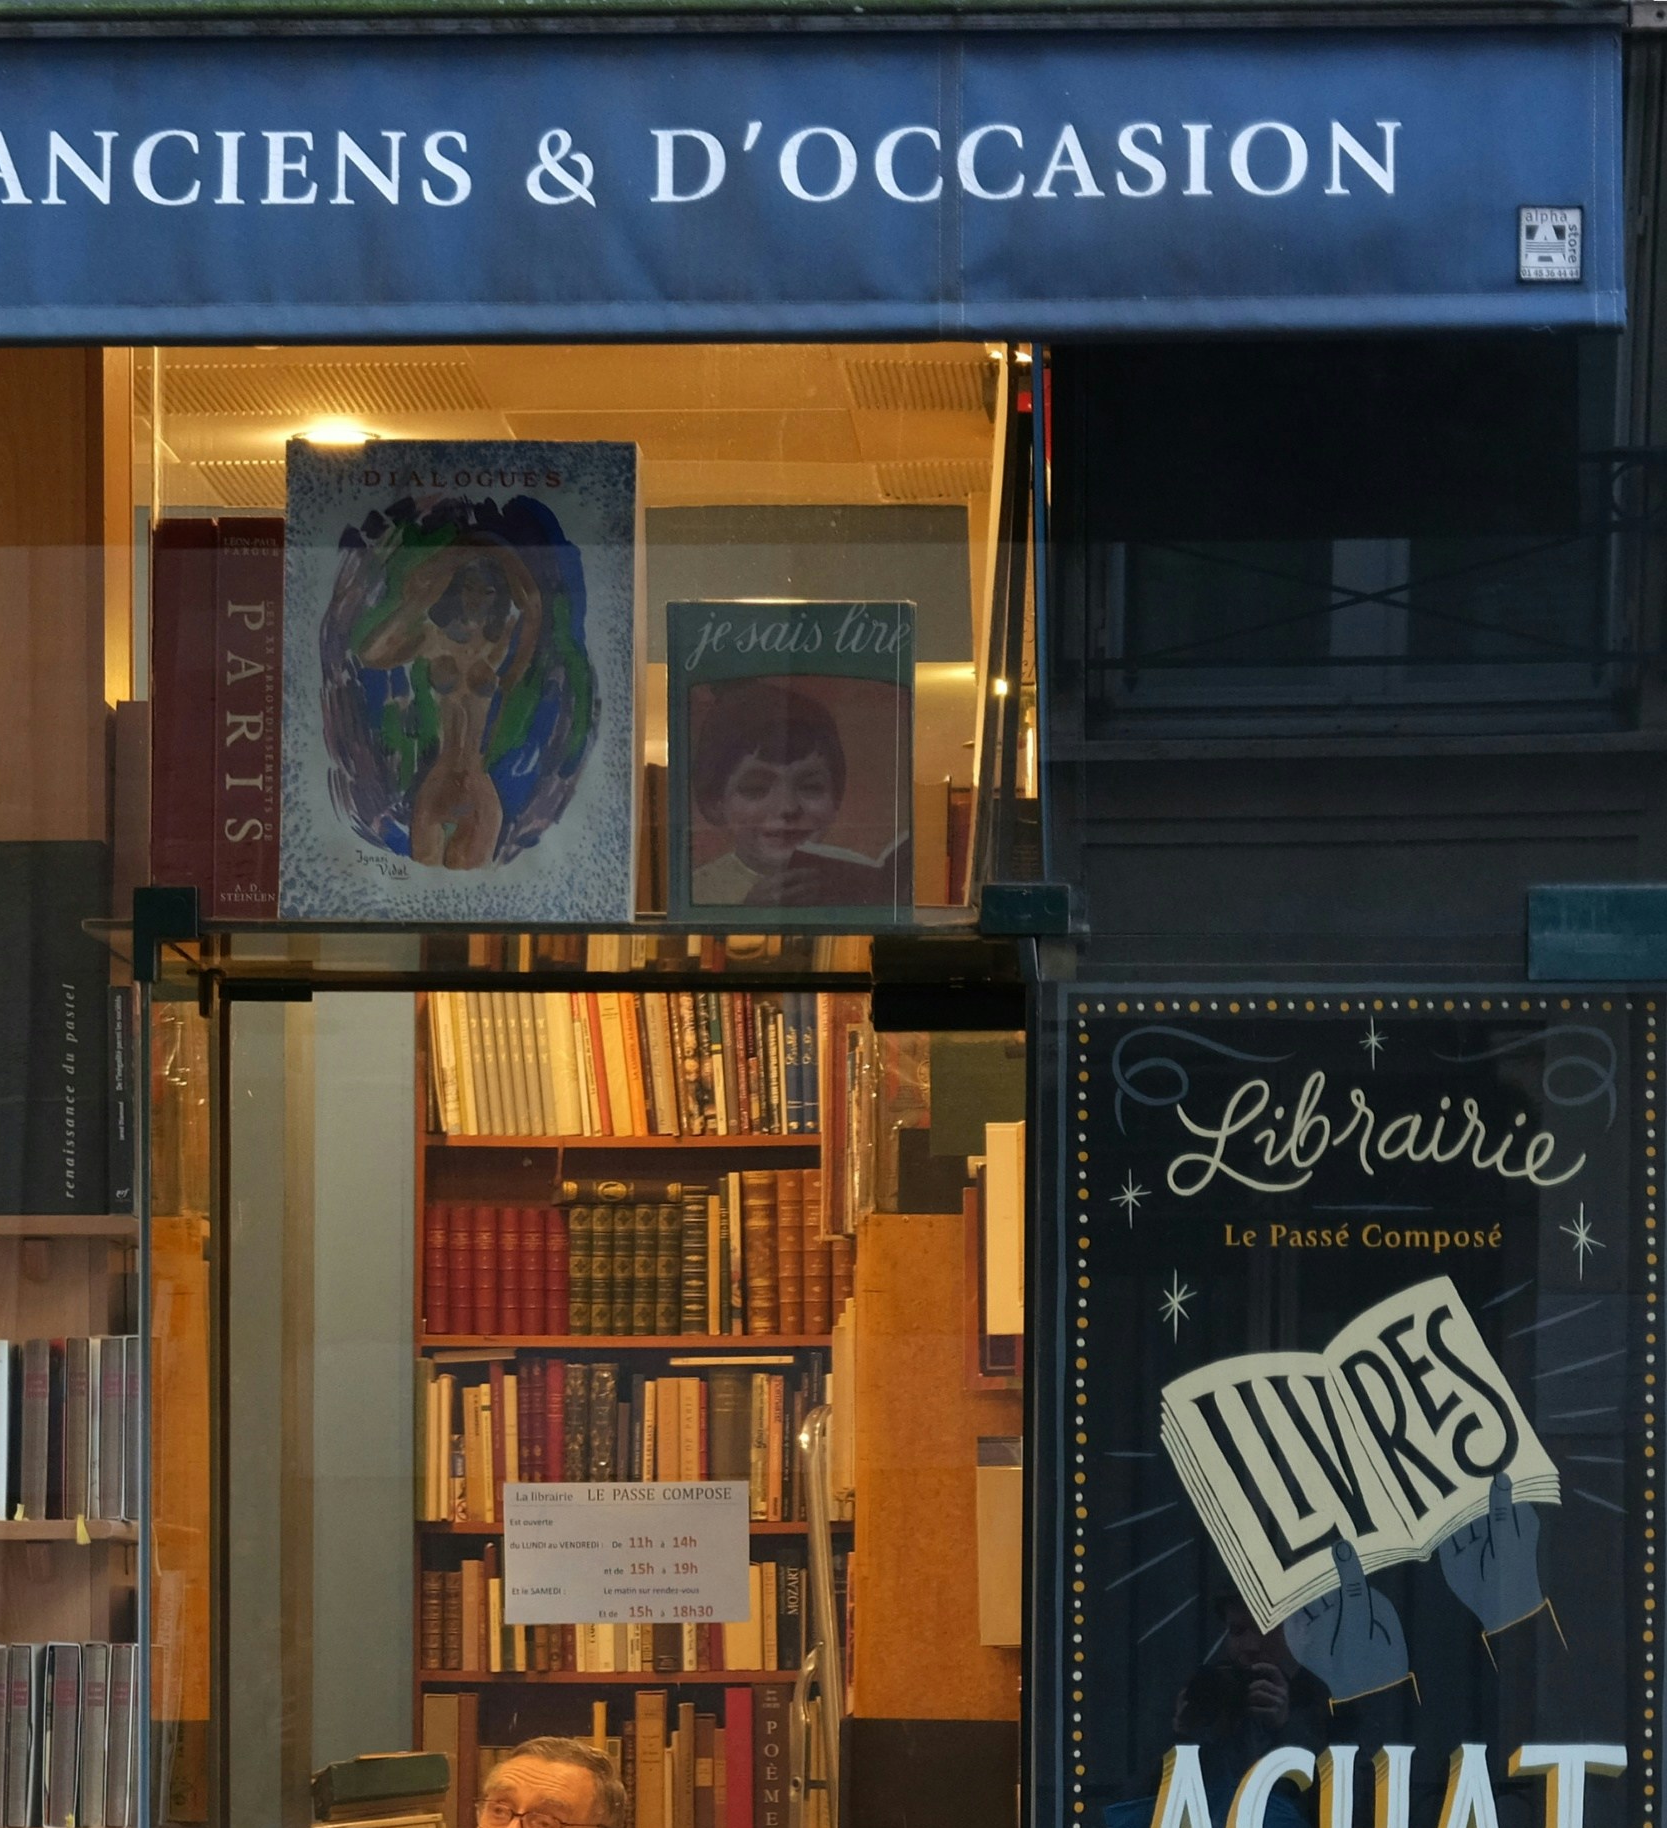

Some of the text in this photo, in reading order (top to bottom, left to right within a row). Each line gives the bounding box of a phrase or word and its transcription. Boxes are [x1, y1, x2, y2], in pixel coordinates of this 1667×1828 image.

[526, 129, 598, 207] &
[650, 119, 1401, 205] D'OCCASION
[1525, 209, 1567, 224] alpha
[1568, 224, 1580, 263] store
[363, 470, 563, 489] DIALOGUES
[684, 603, 912, 671] je sais lire
[224, 601, 263, 843] PARIS
[220, 893, 276, 901] STEINLEN
[65, 982, 78, 1036] pastel
[65, 1085, 77, 1200] renaissance
[1168, 1071, 1586, 1196] Librairie
[1225, 1224, 1503, 1253] Le Passé Composé
[1191, 1304, 1519, 1572] LIVRES
[516, 1488, 731, 1501] La librairie LE PASSE COMPOSE
[522, 1541, 546, 1549] LUNDI
[559, 1541, 599, 1549] VENDREDI
[629, 1537, 653, 1548] 11h
[673, 1536, 697, 1548] 14h
[630, 1563, 654, 1575] 15h
[674, 1563, 697, 1574] 19h
[531, 1587, 560, 1595] SAMEDI
[599, 1610, 607, 1618] Et
[609, 1610, 618, 1618] de
[629, 1606, 653, 1618] 15h
[673, 1606, 713, 1618] 18h30
